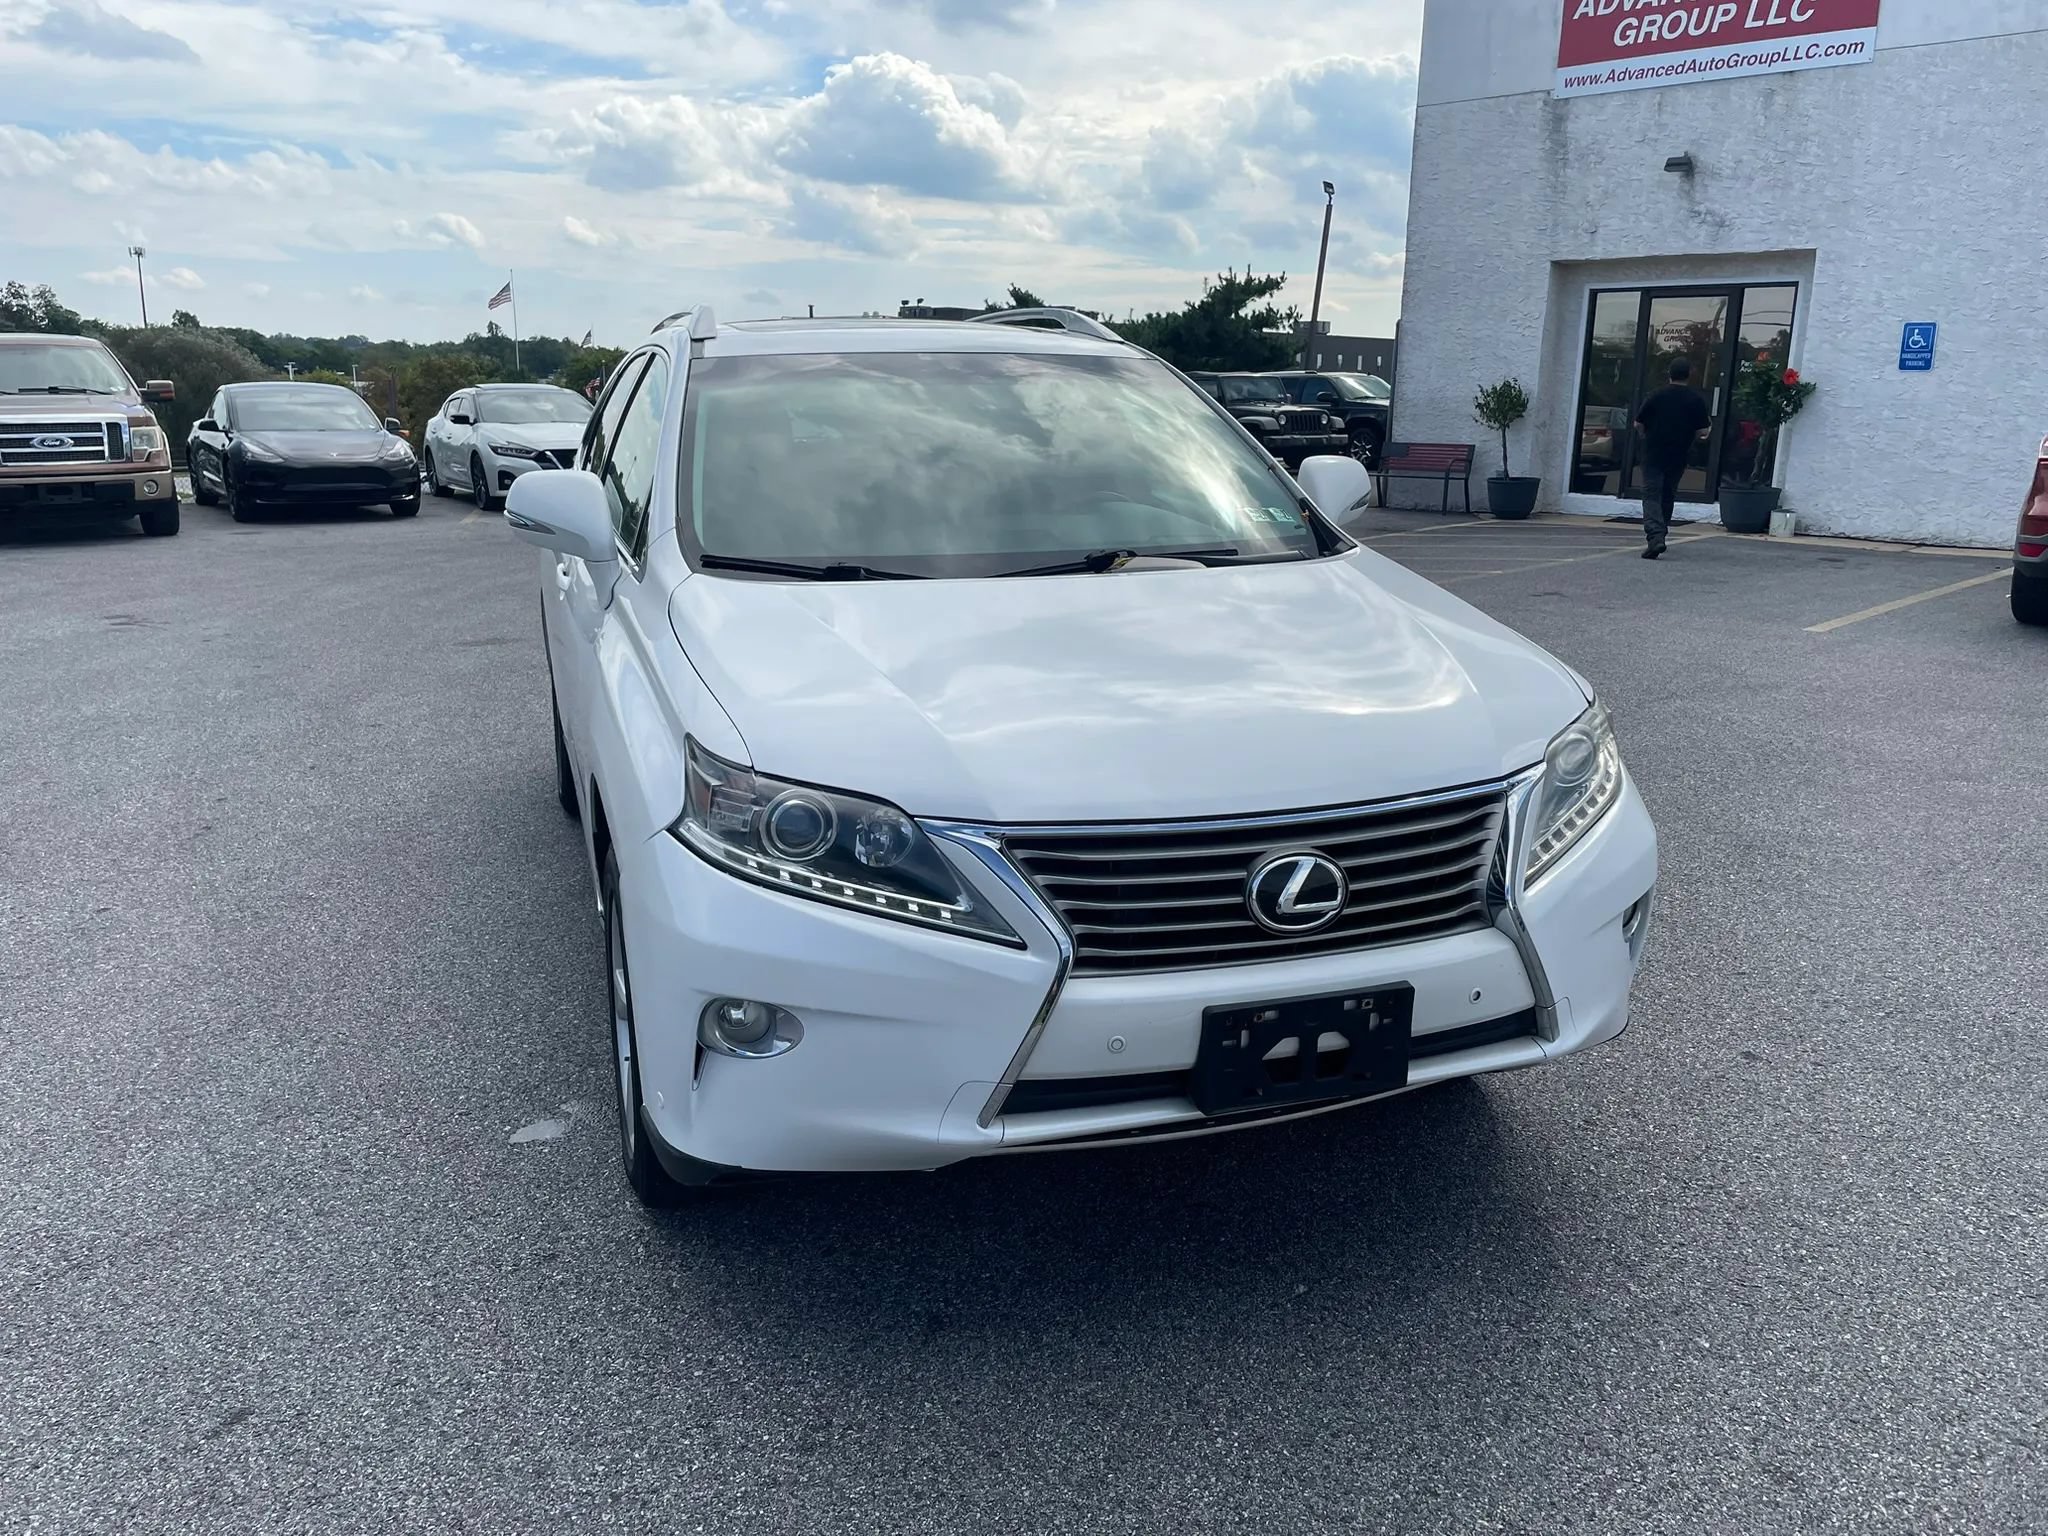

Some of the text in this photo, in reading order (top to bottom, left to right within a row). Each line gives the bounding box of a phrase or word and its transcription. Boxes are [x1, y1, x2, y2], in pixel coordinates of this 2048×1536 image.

[1613, 3, 1738, 47] GROUP
[1744, 0, 1816, 29] LLC
[1564, 40, 1866, 89] www.AdvancedAutoGroupLLC.com
